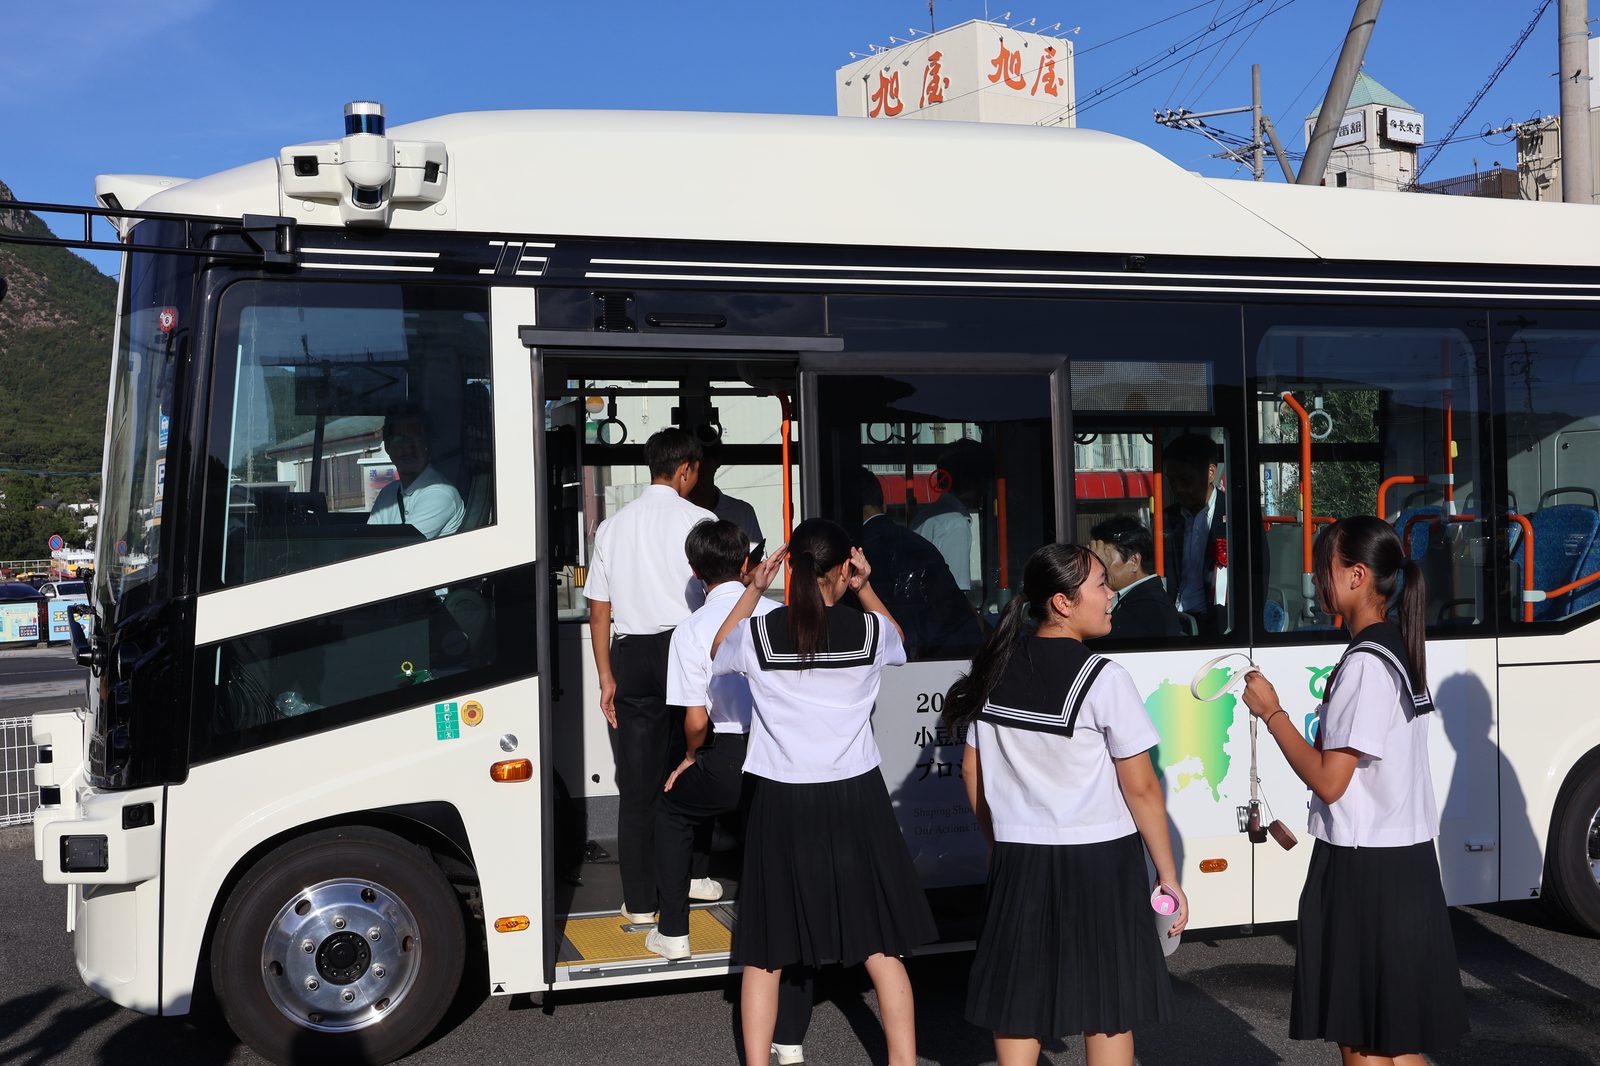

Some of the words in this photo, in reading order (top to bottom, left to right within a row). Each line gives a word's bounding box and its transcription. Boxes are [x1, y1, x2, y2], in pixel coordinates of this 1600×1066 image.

[870, 50, 950, 118] 旭屋
[988, 42, 1064, 97] 旭屋
[914, 807, 950, 819] Shaping
[952, 804, 972, 815] Sho
[914, 825, 933, 835] Our
